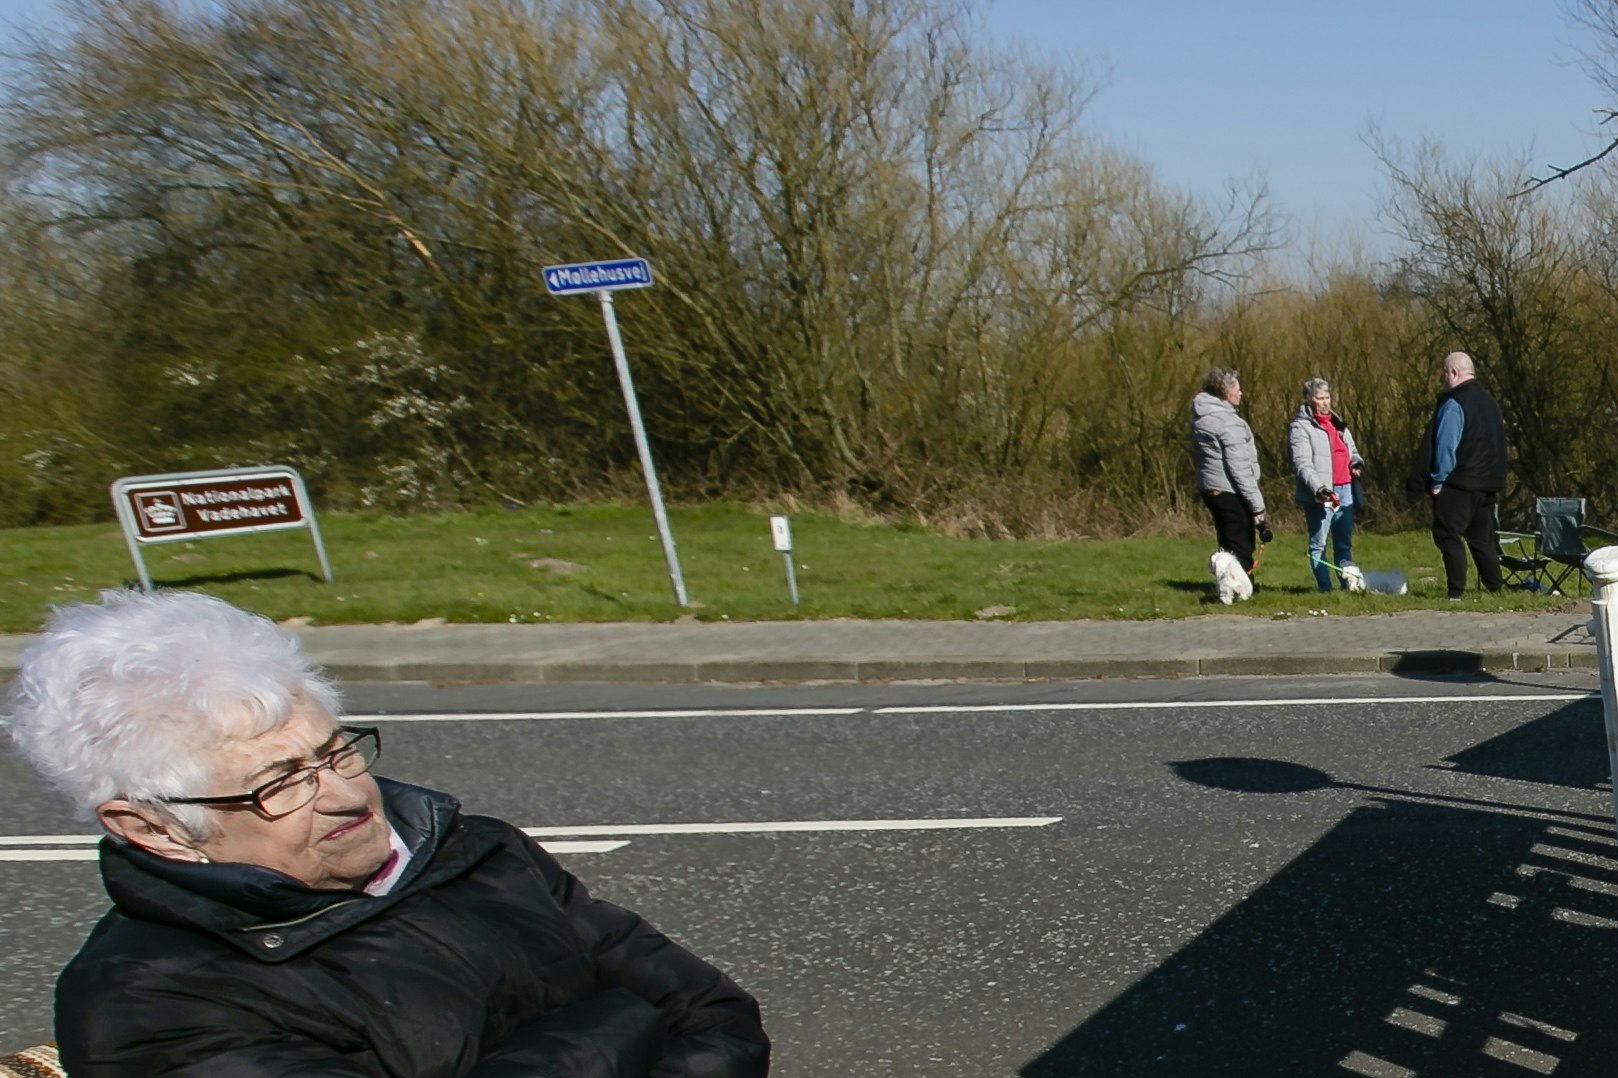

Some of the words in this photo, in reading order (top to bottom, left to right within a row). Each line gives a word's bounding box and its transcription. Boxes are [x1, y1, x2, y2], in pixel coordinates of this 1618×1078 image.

[558, 262, 648, 286] Møllehusvej
[180, 484, 292, 506] Nationalpark
[196, 502, 288, 523] Vadehavet
